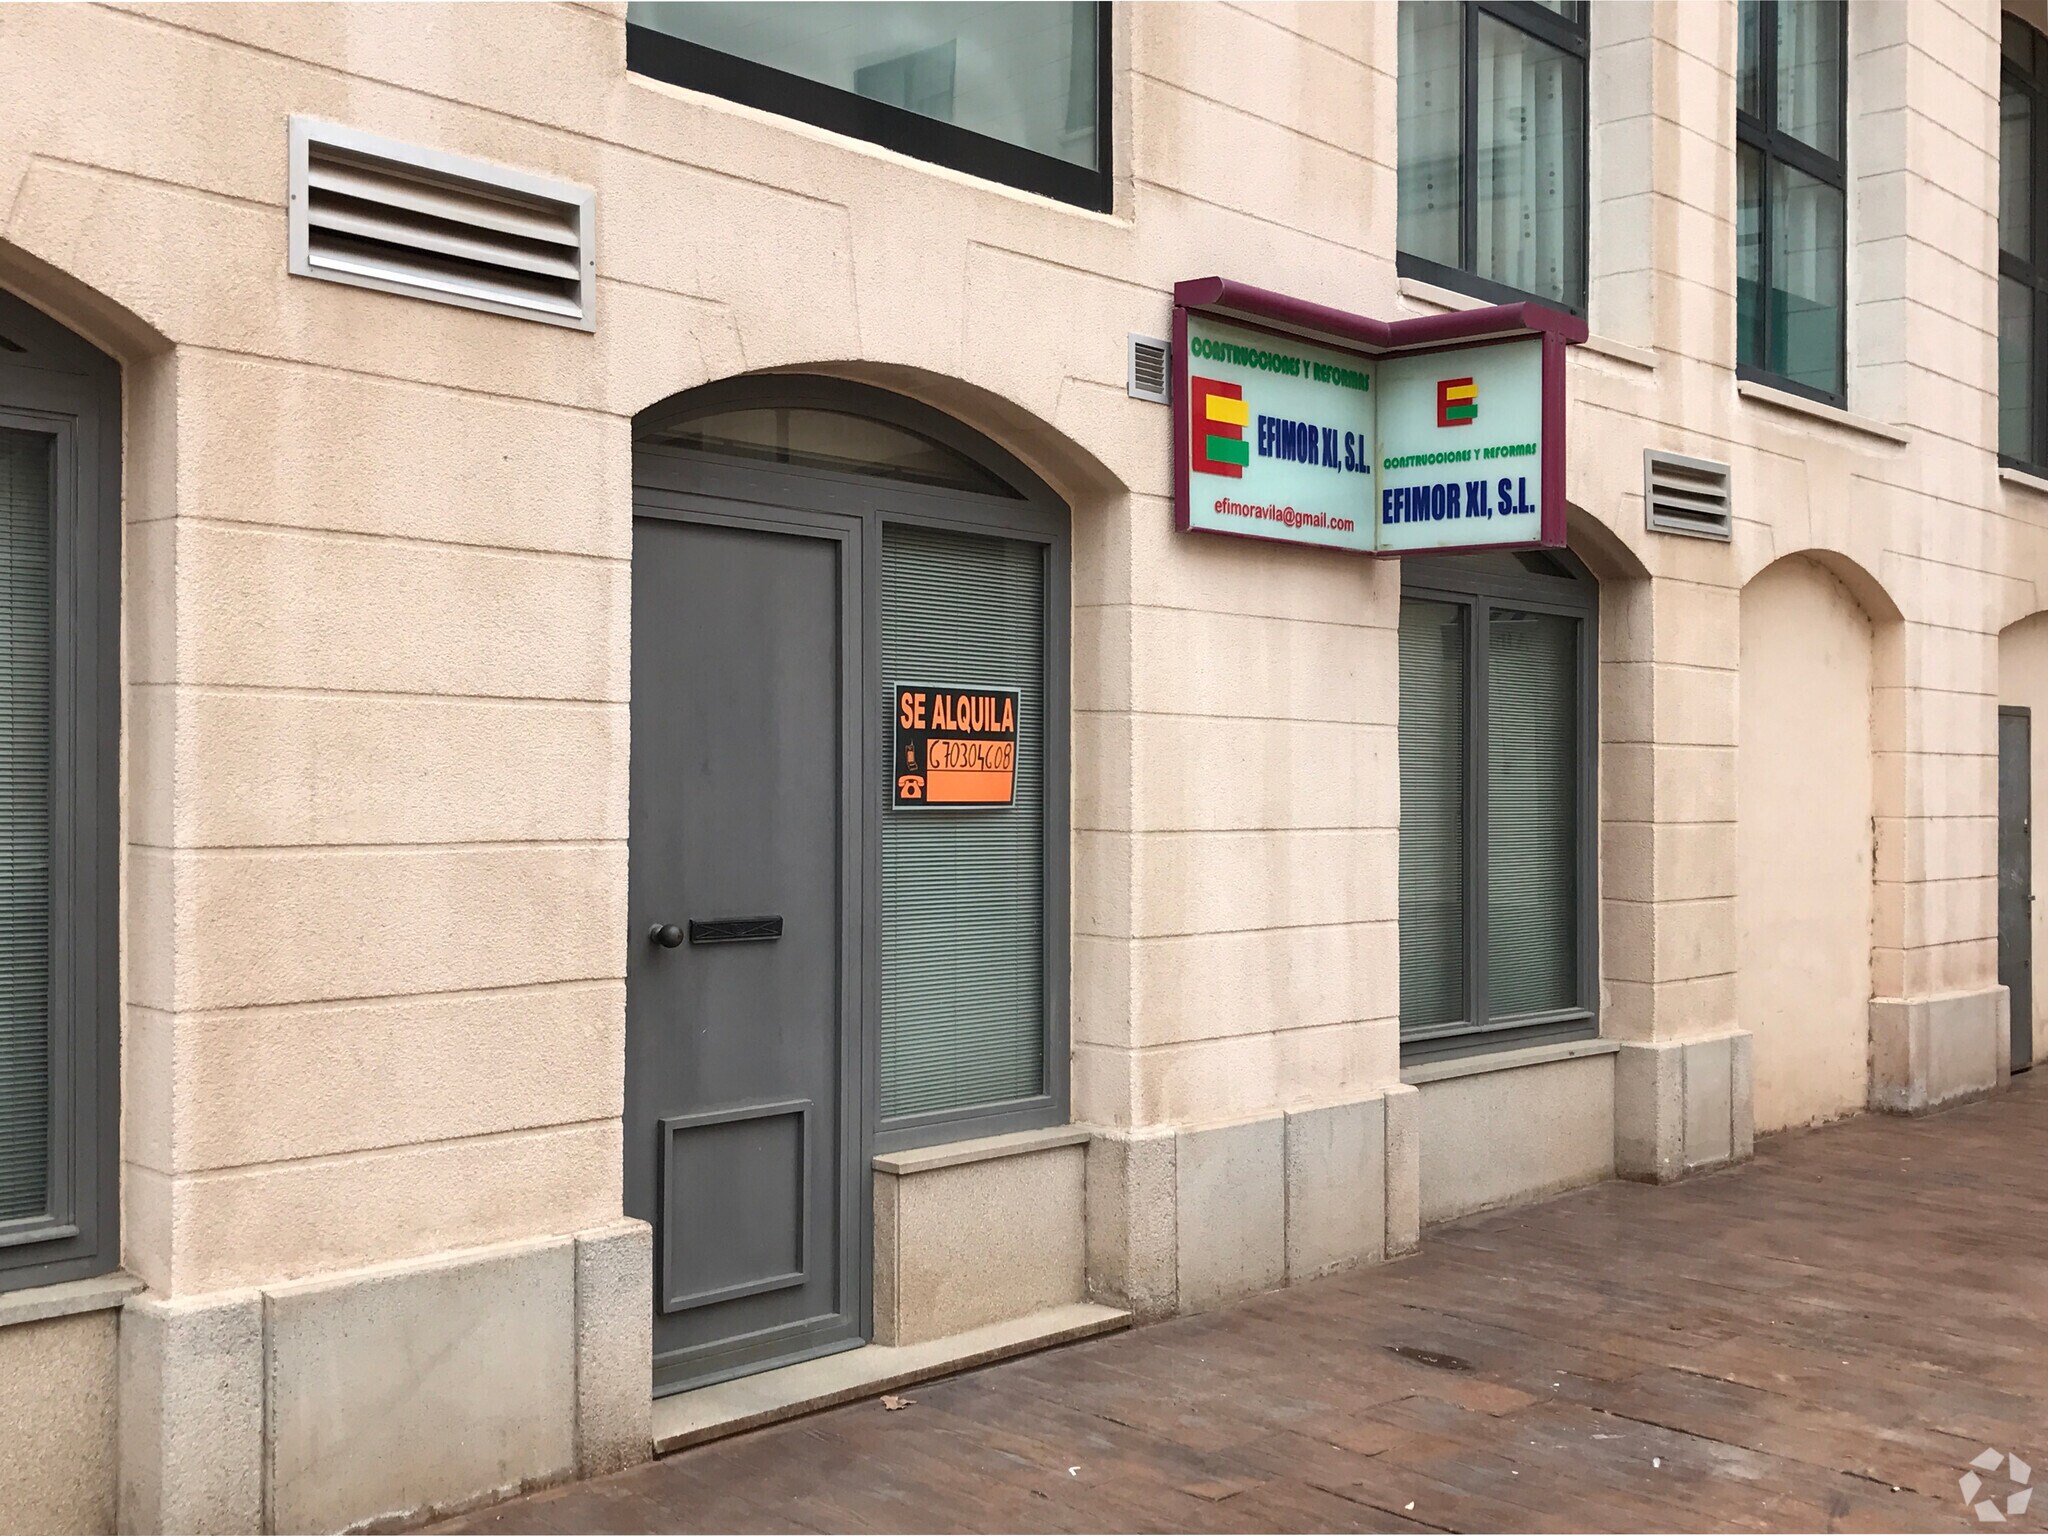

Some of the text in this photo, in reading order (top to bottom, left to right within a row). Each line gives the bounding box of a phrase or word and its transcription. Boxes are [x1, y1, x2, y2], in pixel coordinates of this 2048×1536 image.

[1191, 336, 1370, 392] CONSTRUCCIONES Y REFORMAS
[1257, 414, 1371, 475] EFIMOR XI, S.L.
[1383, 442, 1537, 470] CONSTRUCCIONES Y REFORMAS
[1214, 497, 1355, 533] efimoravila@gmail.com
[1382, 476, 1535, 525] EFIMOR XI, S.L.
[900, 692, 1015, 734] SE ALQUILA
